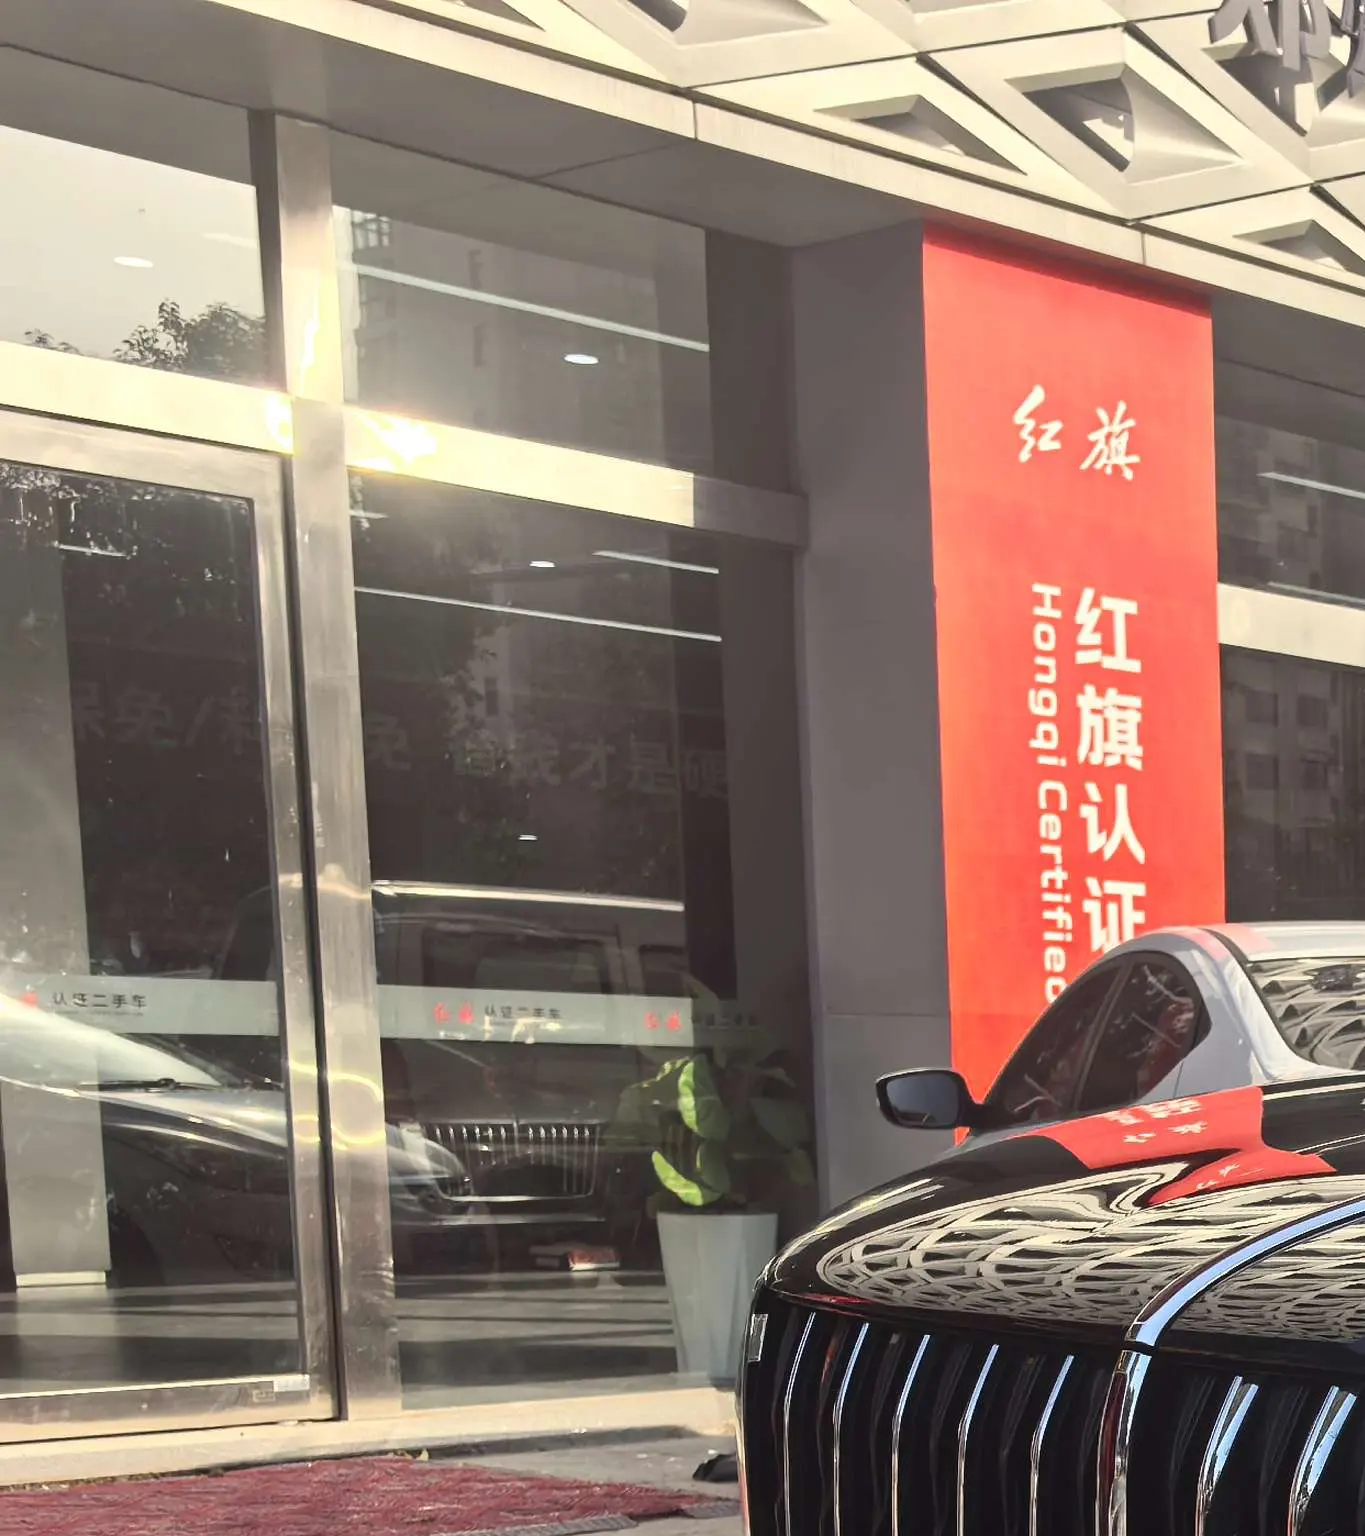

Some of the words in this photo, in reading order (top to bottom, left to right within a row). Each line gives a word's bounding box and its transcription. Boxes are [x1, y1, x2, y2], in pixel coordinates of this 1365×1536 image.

[1013, 385, 1141, 481] 红旗
[1029, 582, 1067, 768] Hongqi
[1074, 586, 1147, 956] 红旗认证
